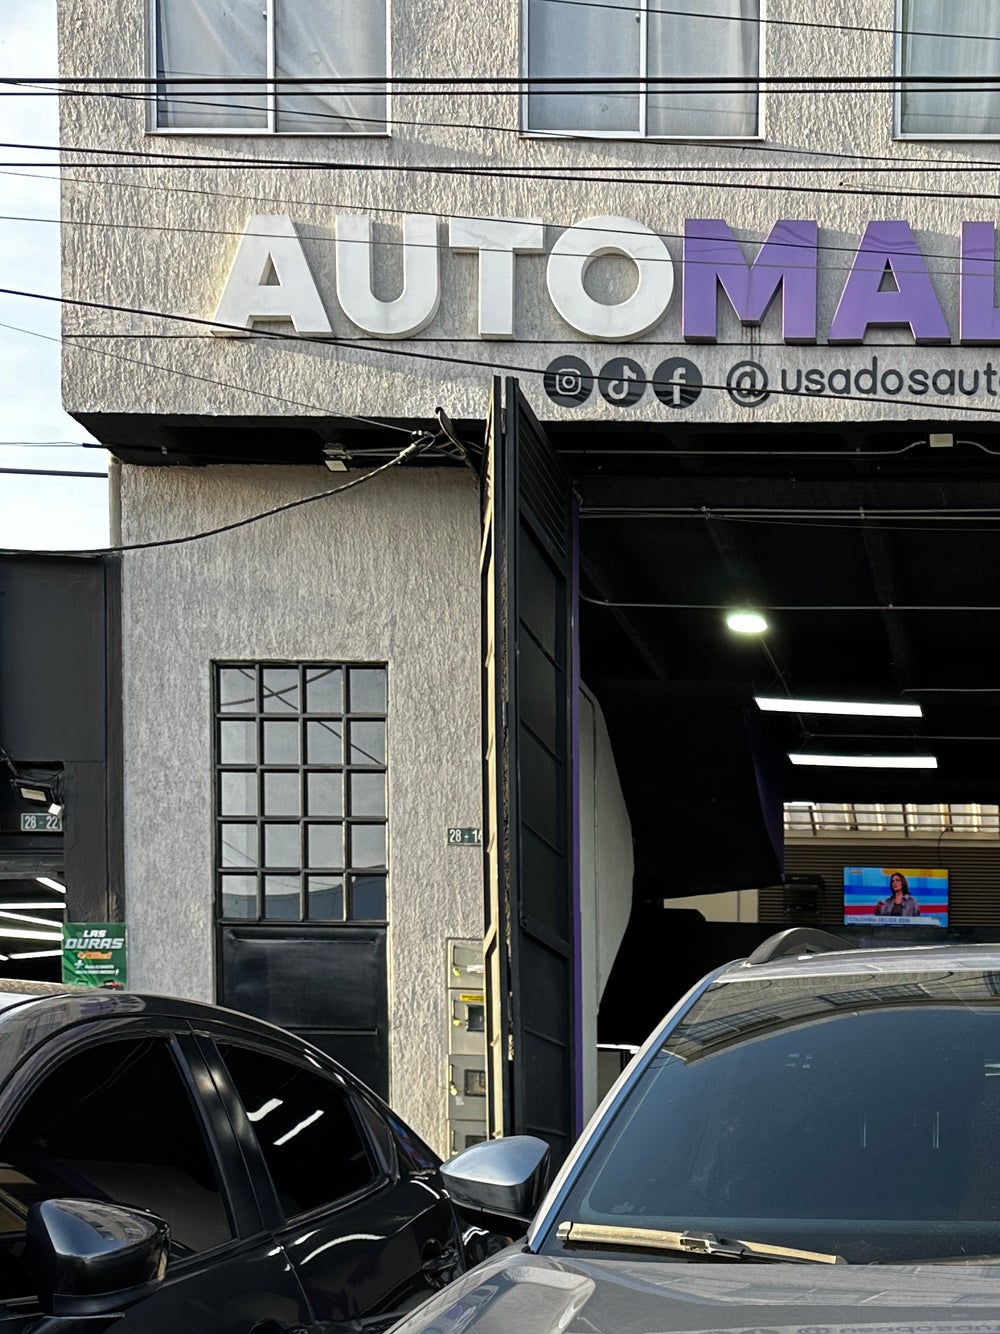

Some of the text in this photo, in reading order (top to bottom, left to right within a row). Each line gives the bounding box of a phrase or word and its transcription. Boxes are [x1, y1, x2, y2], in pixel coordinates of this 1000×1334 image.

[25, 815, 37, 829] 28
[46, 815, 58, 829] 22
[449, 829, 462, 843] 28
[83, 929, 107, 938] LAS
[64, 938, 125, 949] DURAS
